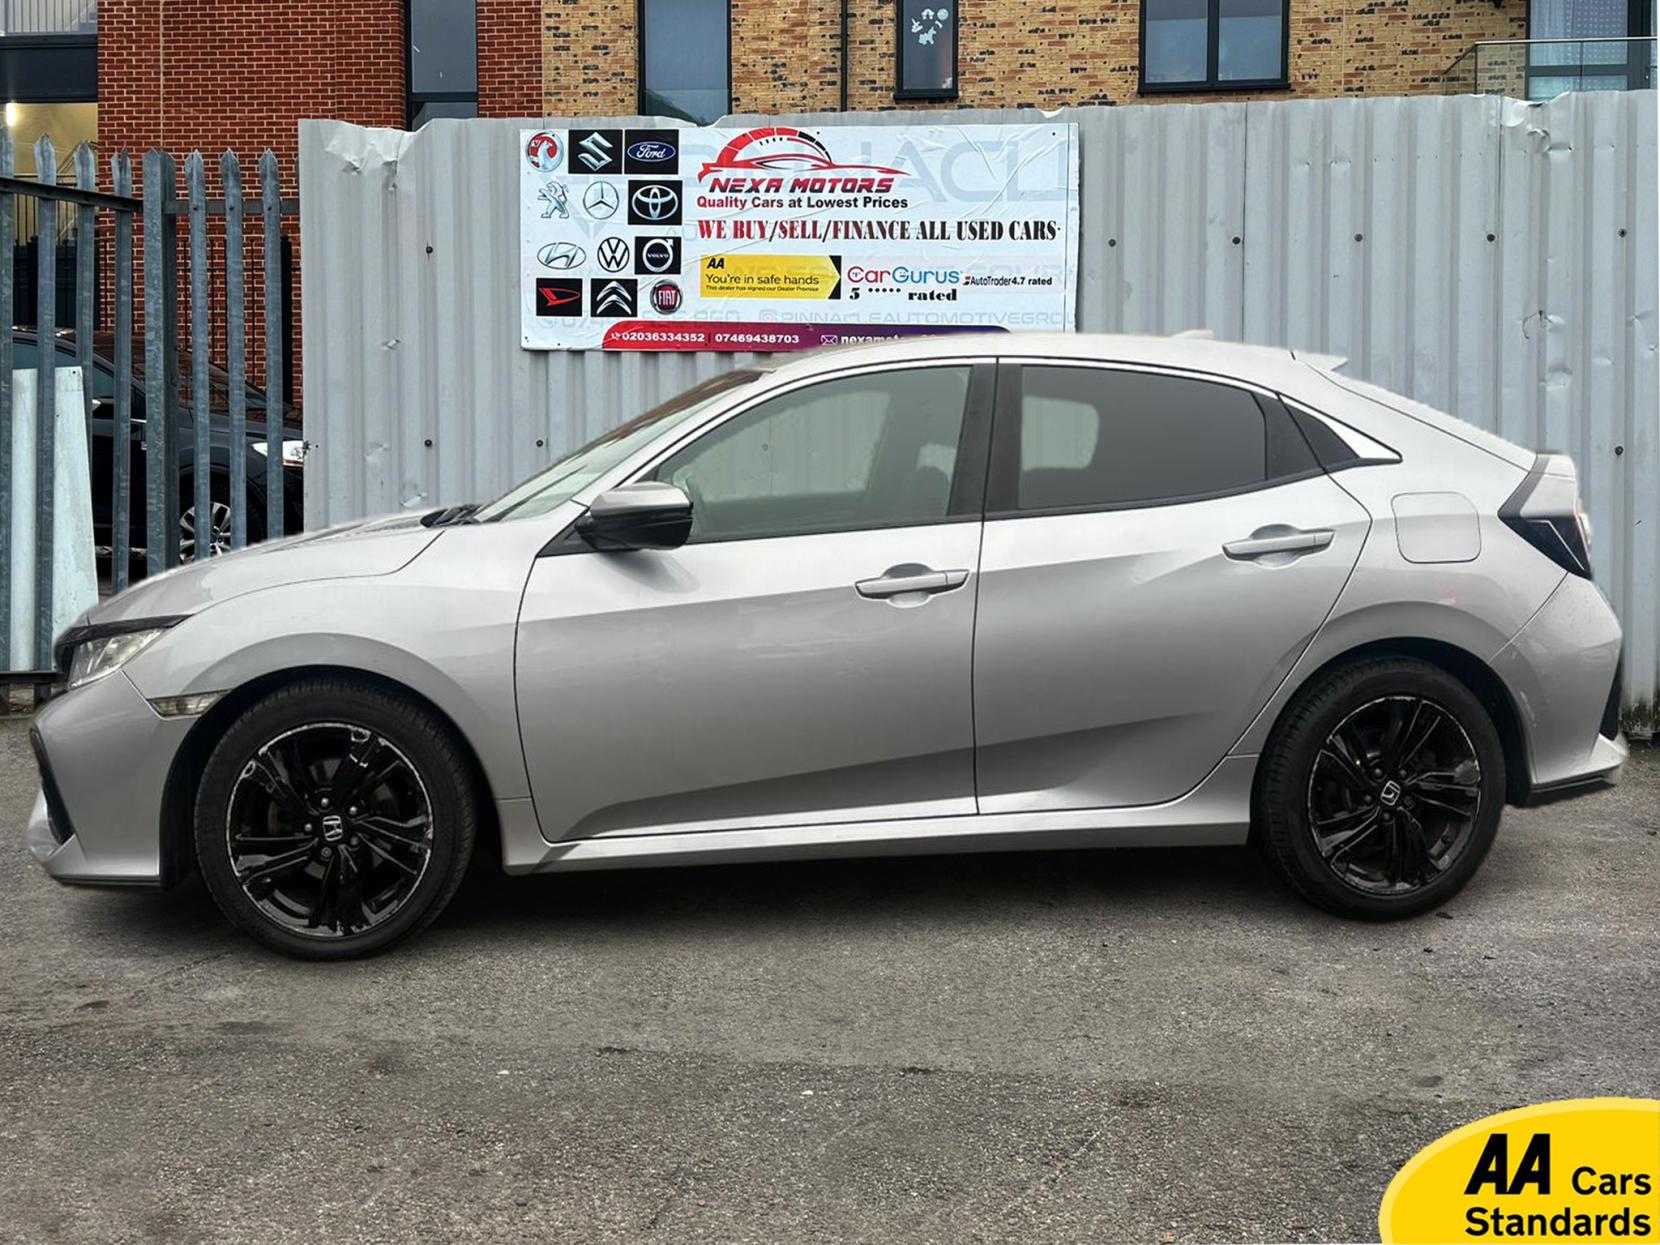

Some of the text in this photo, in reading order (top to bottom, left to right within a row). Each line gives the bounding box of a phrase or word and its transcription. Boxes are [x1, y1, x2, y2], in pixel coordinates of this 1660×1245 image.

[636, 144, 666, 159] Ford
[709, 178, 894, 193] NEXA MOTORS
[697, 196, 908, 210] Quality Cars at Lowest Prices
[698, 220, 727, 239] WE
[916, 220, 950, 240] ALL
[957, 220, 1003, 240] USED
[1009, 220, 1057, 240] CARS
[707, 257, 725, 269] AA
[706, 273, 820, 285] You're in safe hands
[848, 266, 960, 284] CarGurus
[1028, 277, 1052, 286] rated
[658, 290, 676, 306] FIAT
[849, 288, 957, 301] 5 rated
[622, 332, 799, 344] 02036334352 07469438703
